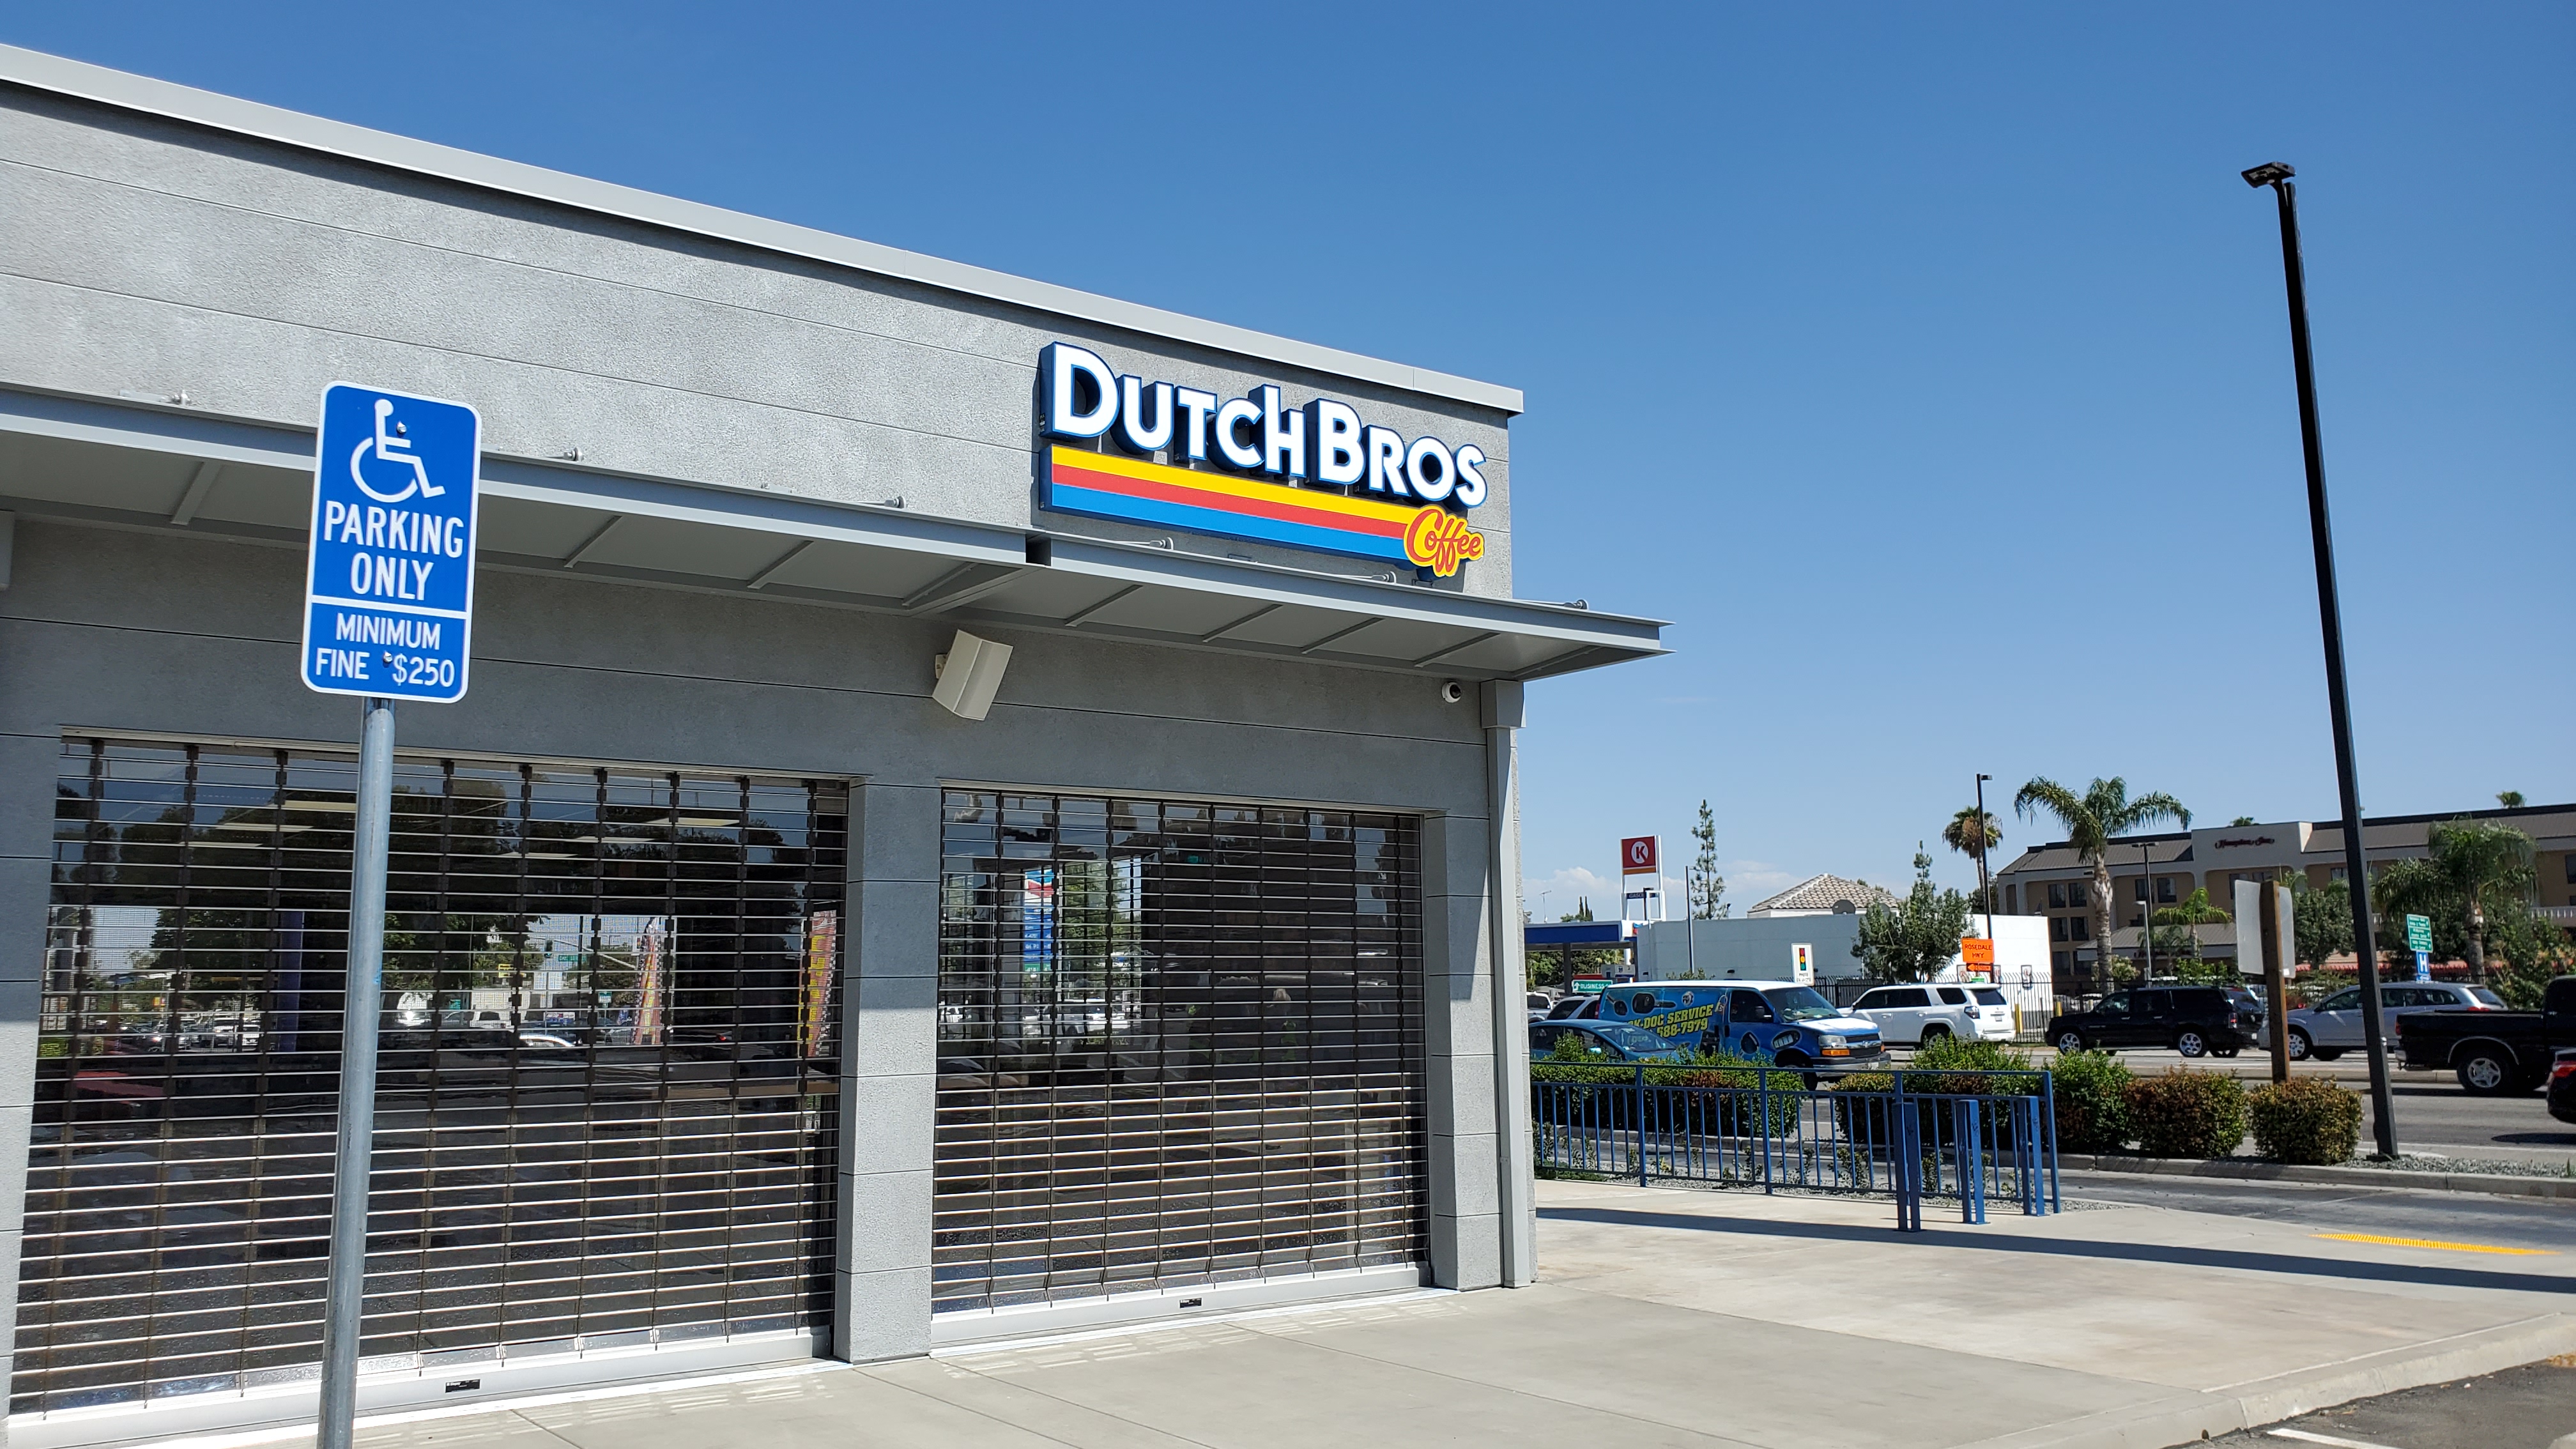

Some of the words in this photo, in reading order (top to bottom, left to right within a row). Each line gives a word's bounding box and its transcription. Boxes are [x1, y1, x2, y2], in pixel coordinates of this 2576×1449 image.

[1052, 341, 1307, 479] DUTCH
[1317, 398, 1489, 509] BROS
[324, 501, 464, 558] PARKING
[1407, 509, 1483, 574] Coffee
[350, 552, 434, 601] ONLY
[336, 613, 441, 650] MINIMUM
[316, 648, 370, 680] FINE
[392, 653, 456, 687] $250
[1636, 845, 1646, 861] K
[2419, 953, 2428, 972] H
[1657, 1018, 1708, 1038] 588-7979
[1667, 1004, 1714, 1024] SERVICE
